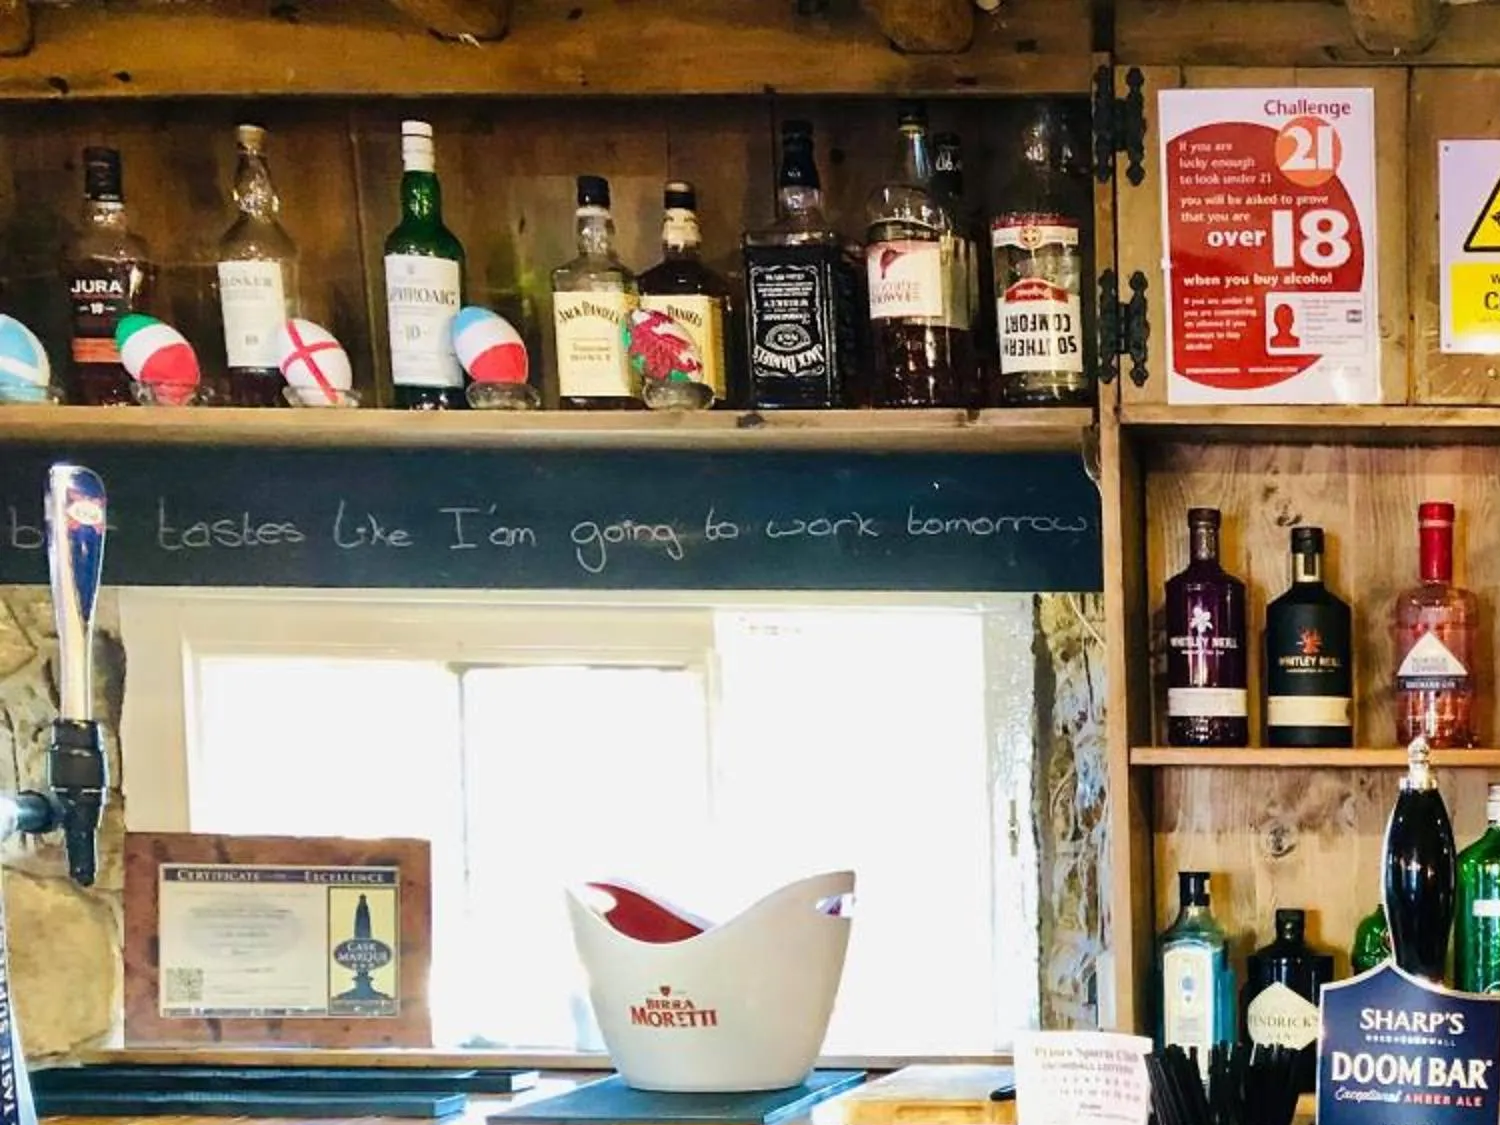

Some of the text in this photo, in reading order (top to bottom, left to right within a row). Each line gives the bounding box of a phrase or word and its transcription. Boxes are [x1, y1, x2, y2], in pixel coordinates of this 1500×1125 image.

[1264, 99, 1352, 117] Challenge
[1190, 142, 1211, 153] you
[1215, 142, 1232, 151] are
[1279, 126, 1334, 171] 21
[1179, 157, 1255, 170] lucky enough
[1195, 174, 1220, 185] look
[1223, 174, 1256, 185] under
[1181, 194, 1329, 207] you will be asked to prove
[1181, 211, 1250, 224] that you are
[1207, 209, 1352, 268] over 18
[71, 279, 123, 293] JURA
[1184, 273, 1332, 288] when you buy alcohol
[795, 344, 825, 370] JACK
[157, 496, 306, 550] tastes
[570, 519, 685, 573] going
[704, 507, 740, 540] to
[766, 511, 880, 538] work
[905, 506, 1088, 536] tomorrow
[177, 870, 261, 882] CERTIFICATE
[304, 870, 385, 883] EXCELLENCE
[646, 998, 696, 1010] BIRRA
[631, 1006, 717, 1028] MORETTI
[1359, 1007, 1465, 1035] SHARP'S
[1331, 1051, 1488, 1090] DOOM BAR
[1335, 1086, 1482, 1107] Exceptional AMBER ALE
